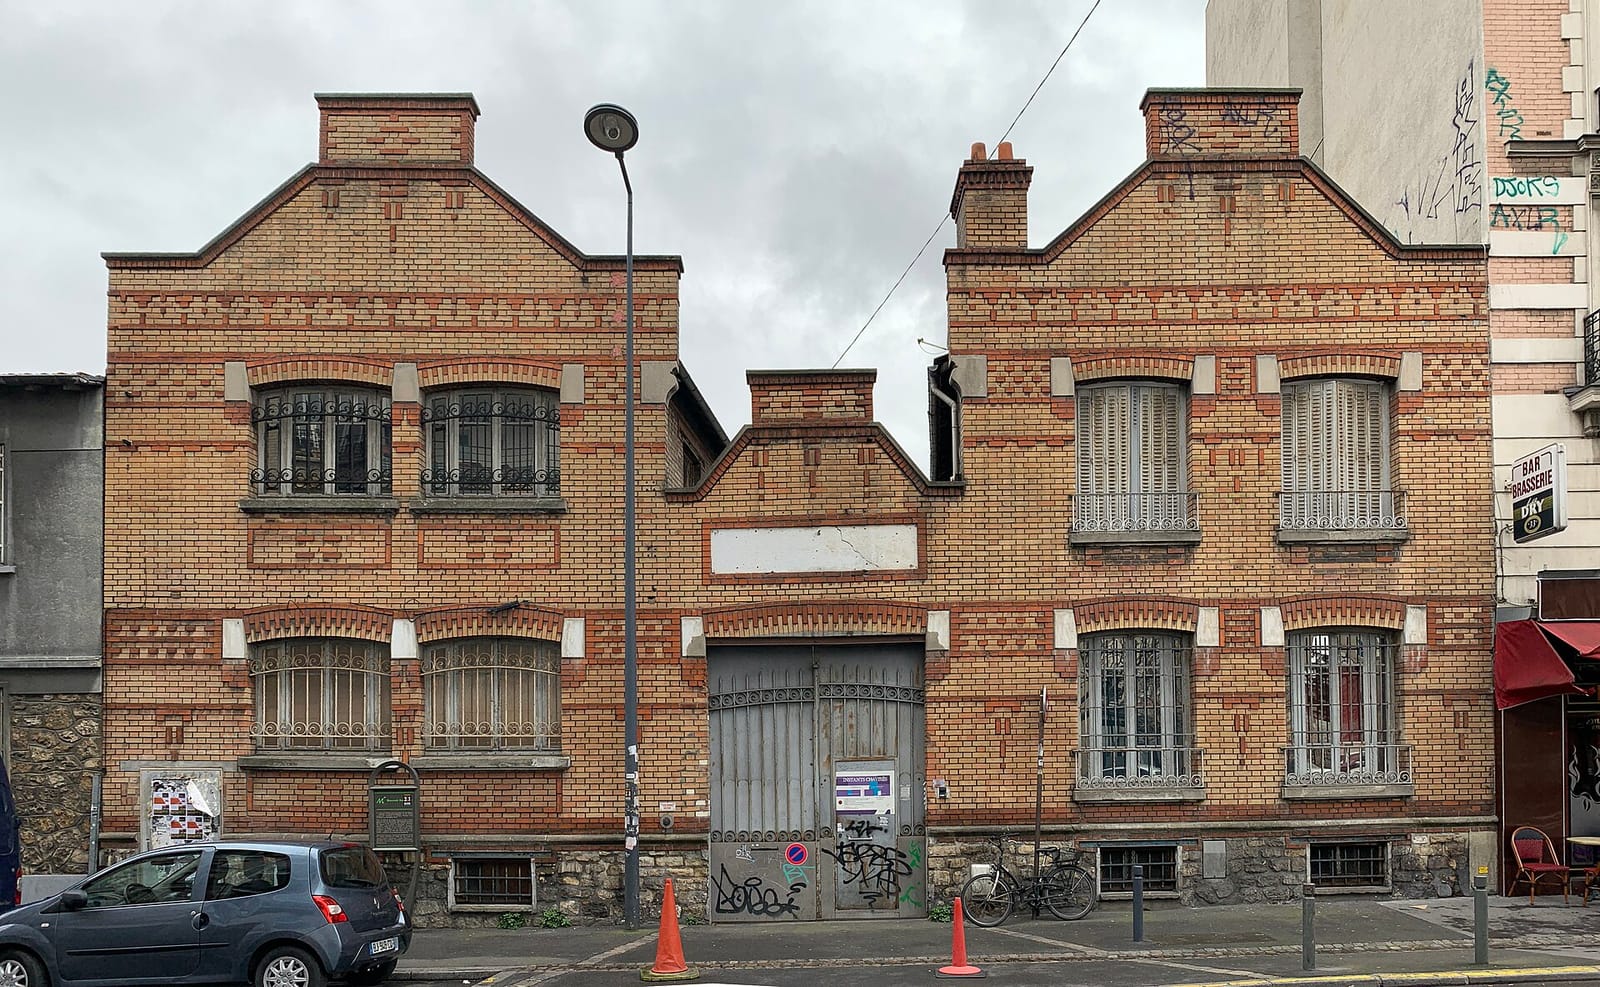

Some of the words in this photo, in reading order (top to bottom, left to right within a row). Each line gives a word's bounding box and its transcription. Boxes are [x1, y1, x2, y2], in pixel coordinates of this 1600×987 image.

[1522, 456, 1541, 477] BAR
[1512, 469, 1553, 499] BRASSERIE
[1521, 498, 1545, 519] DRY
